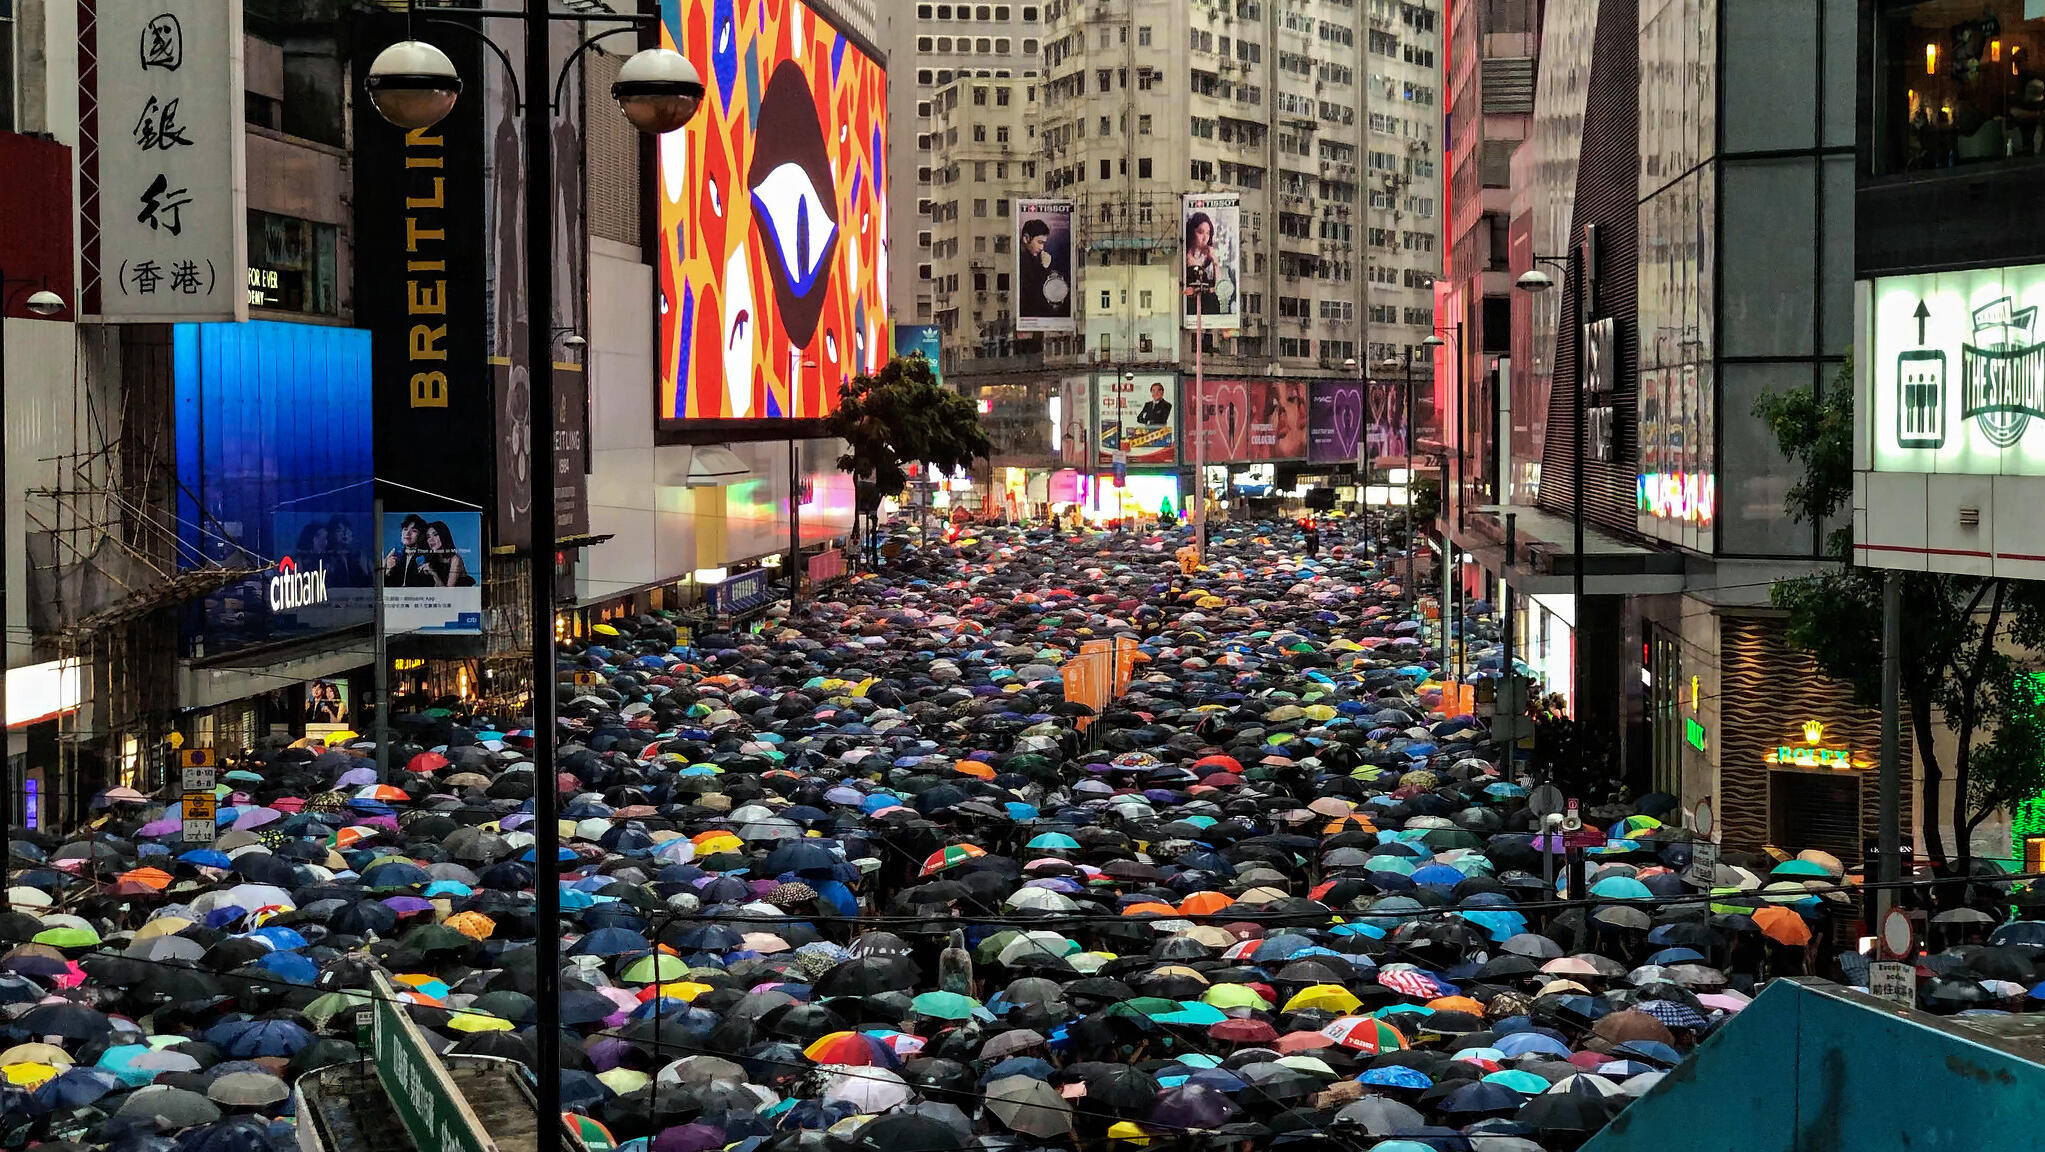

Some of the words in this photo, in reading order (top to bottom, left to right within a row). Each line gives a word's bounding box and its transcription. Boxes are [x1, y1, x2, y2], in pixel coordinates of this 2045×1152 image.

[1039, 204, 1070, 212] TISSOT
[1204, 199, 1235, 208] TISSOT
[1965, 349, 1987, 412] THE
[1989, 346, 2045, 414] STADIUM
[270, 559, 328, 612] citibank
[1778, 746, 1849, 766] ROLEX
